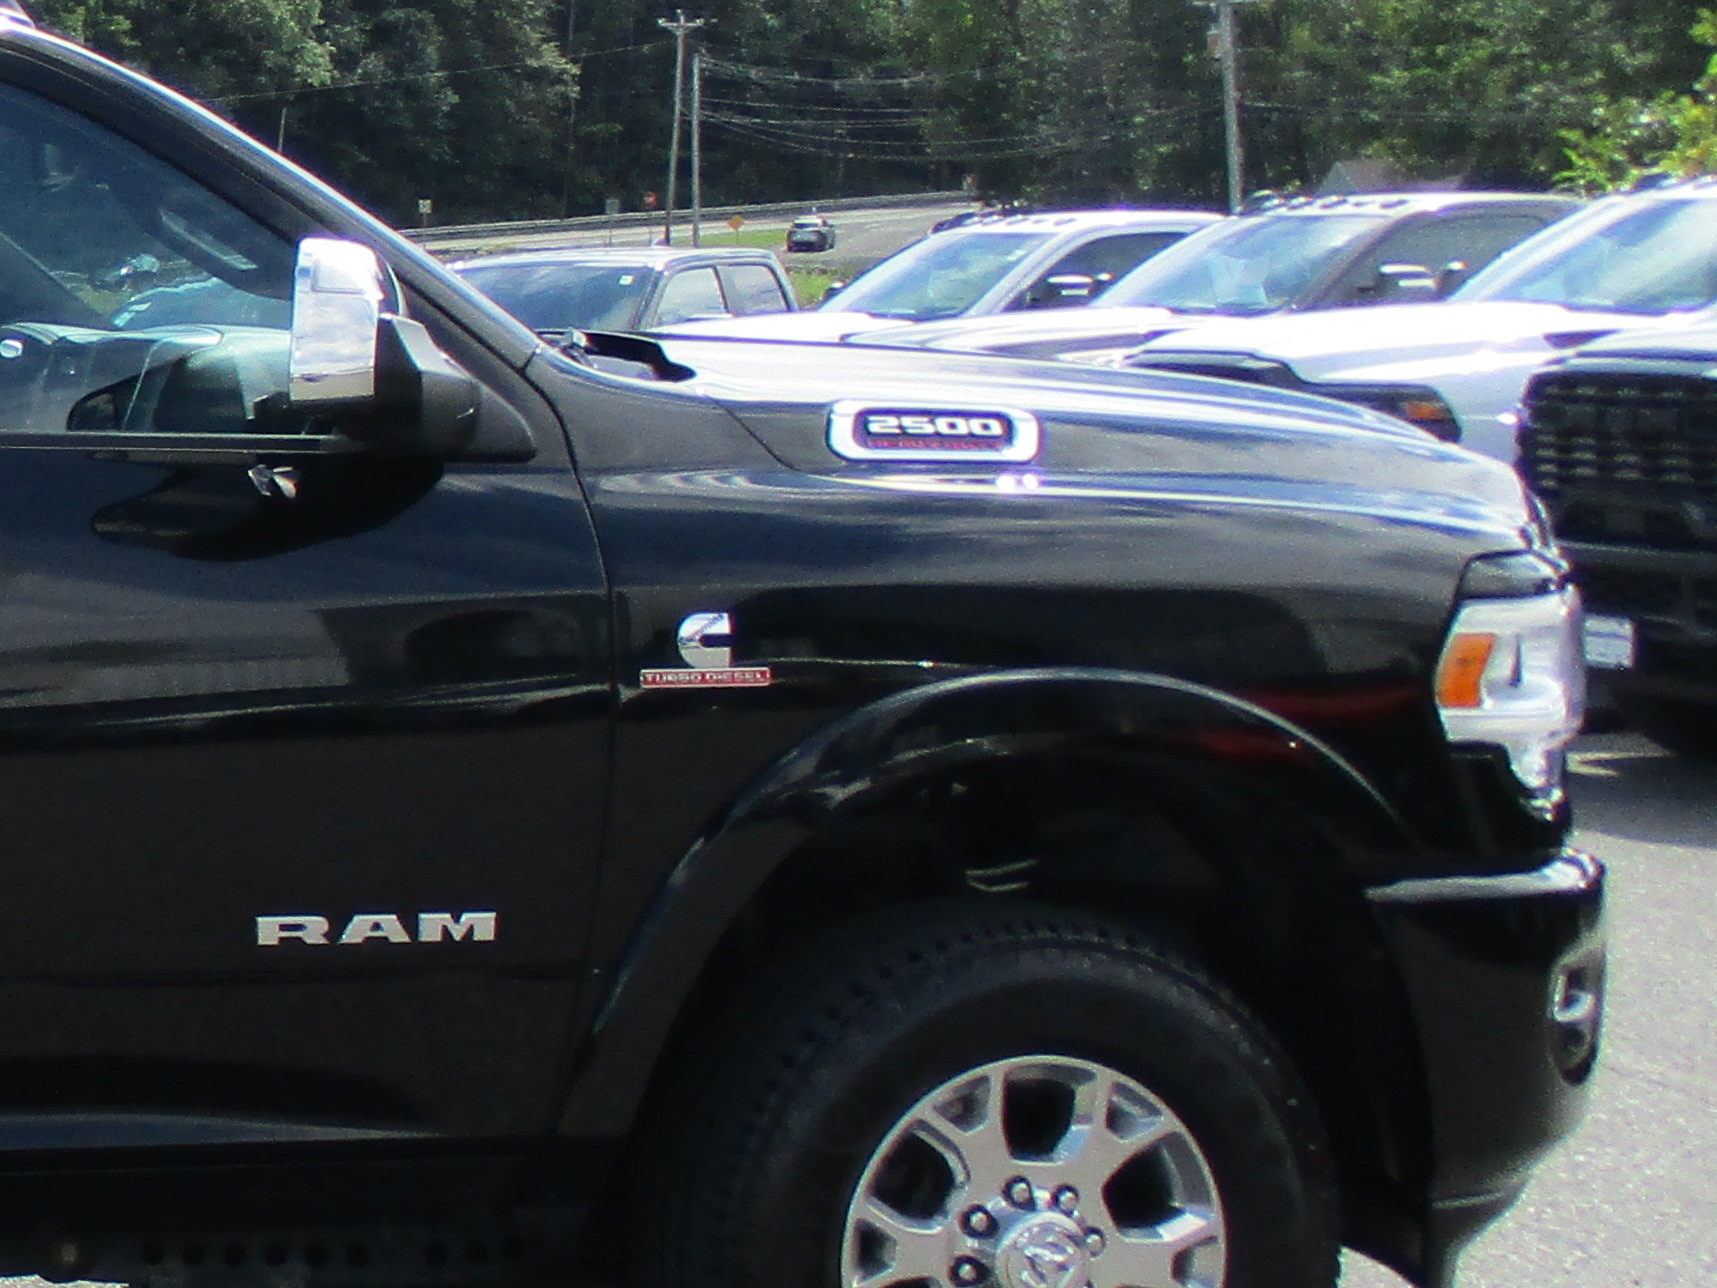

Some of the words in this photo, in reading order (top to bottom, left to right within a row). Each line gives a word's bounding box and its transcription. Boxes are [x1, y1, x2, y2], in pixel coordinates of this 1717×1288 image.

[867, 415, 1004, 436] 2500
[704, 670, 765, 683] DIESEL
[255, 912, 497, 945] RAM
